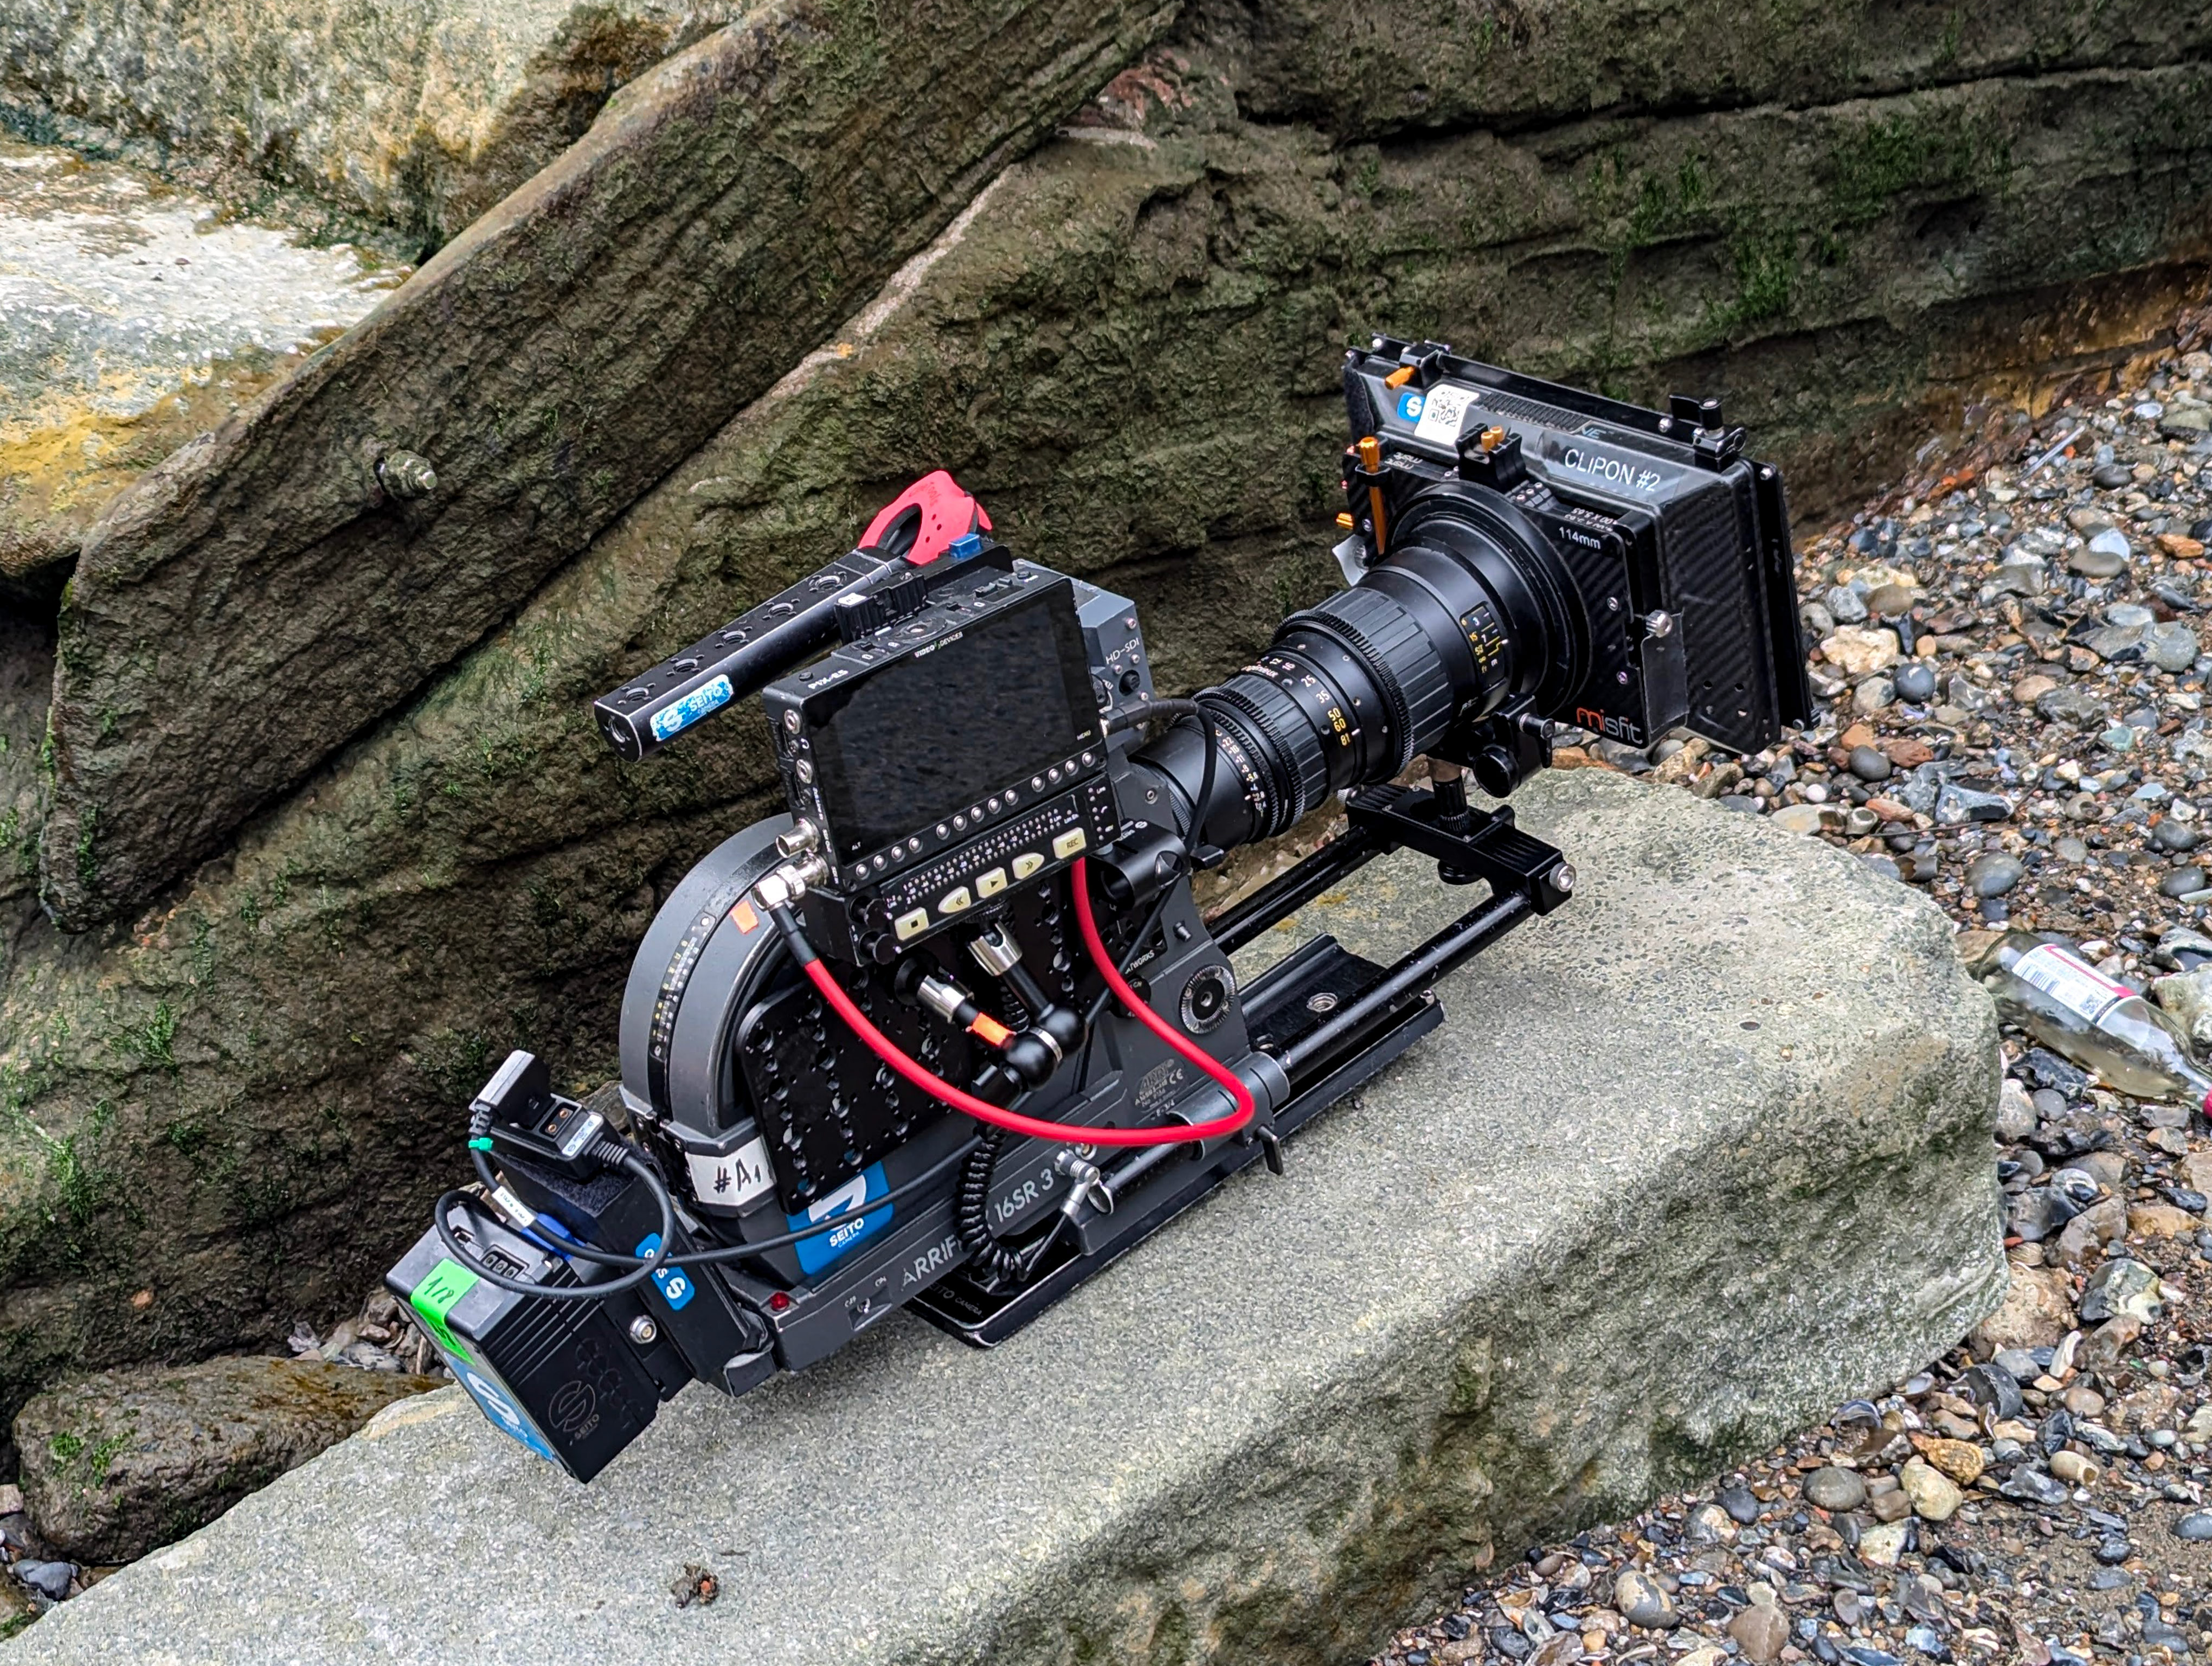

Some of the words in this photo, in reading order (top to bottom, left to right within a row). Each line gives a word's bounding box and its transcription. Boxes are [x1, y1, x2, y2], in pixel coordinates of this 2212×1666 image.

[1636, 470, 1661, 491] #2
[1559, 527, 1601, 549] 114mm
[1105, 637, 1140, 664] HD-SDI
[1301, 675, 1316, 687] 25
[687, 685, 723, 712] SEITO
[1315, 690, 1330, 703] 35
[1328, 708, 1341, 721] 50
[1333, 719, 1347, 732] 60
[1576, 707, 1643, 745] misfit
[994, 1180, 1039, 1223] 16SR
[1040, 1168, 1053, 1191] 3
[829, 1218, 864, 1247] SEITO
